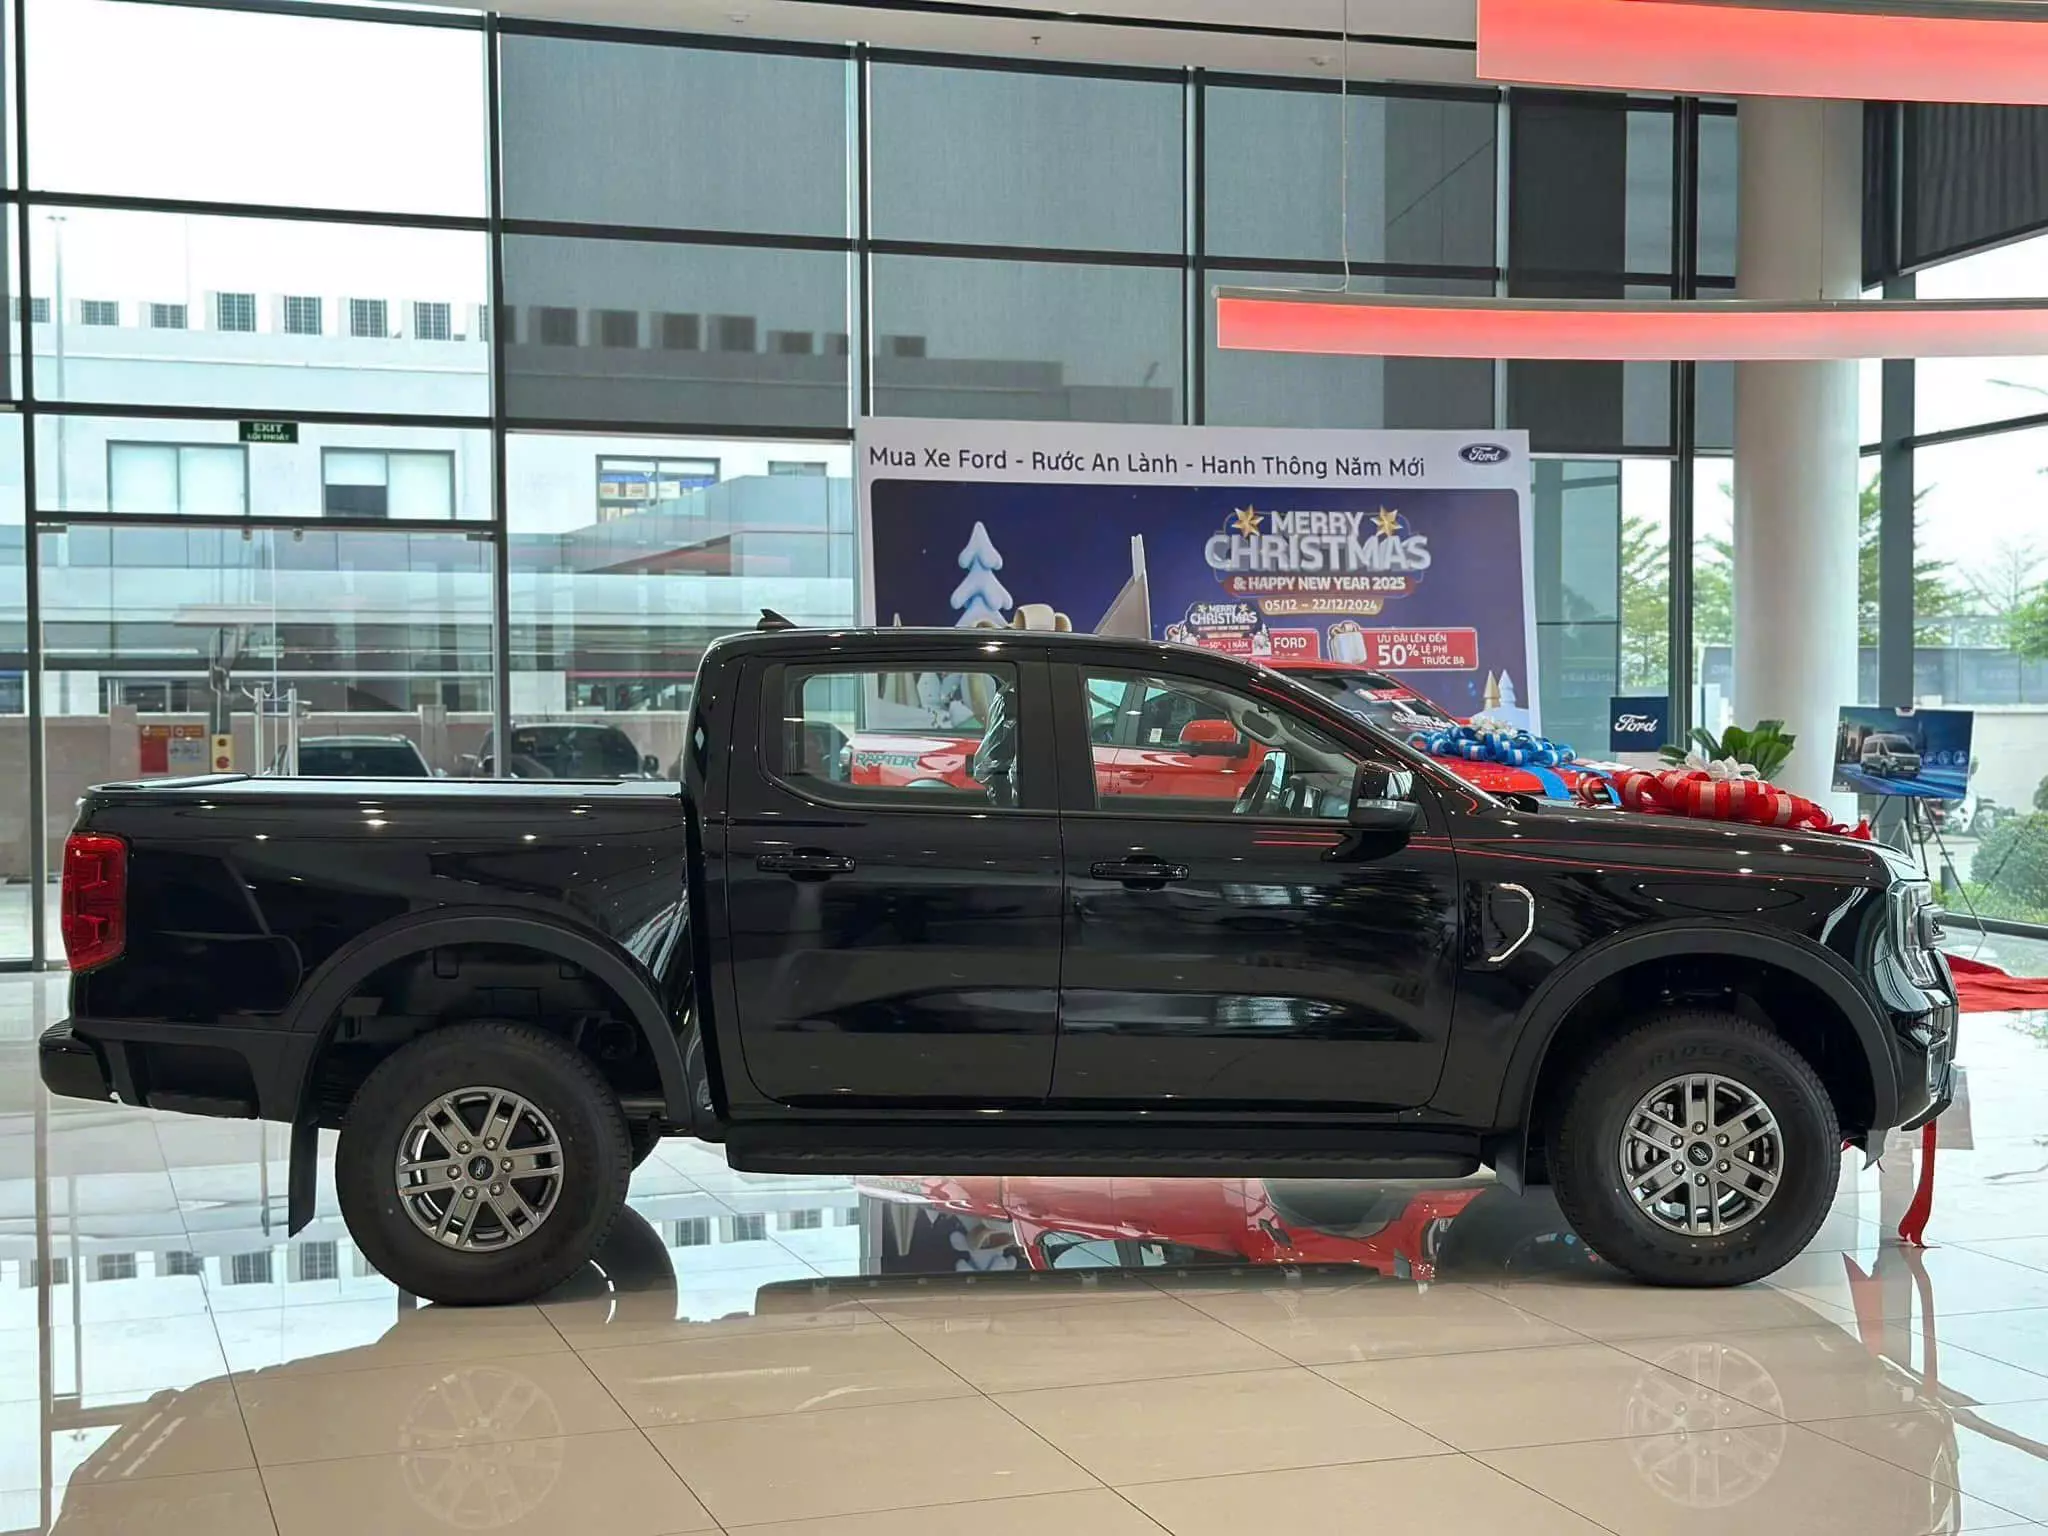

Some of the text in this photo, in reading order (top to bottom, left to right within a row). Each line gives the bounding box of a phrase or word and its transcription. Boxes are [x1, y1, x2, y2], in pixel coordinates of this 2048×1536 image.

[253, 423, 283, 432] EXIT
[870, 446, 916, 467] Mua
[924, 448, 950, 468] Xe
[959, 449, 1007, 469] Ford
[1032, 451, 1085, 471] Rước
[1092, 453, 1119, 472] An
[1127, 453, 1177, 473] Lành
[1202, 455, 1255, 475] Hanh
[1262, 457, 1328, 479] Thông
[1335, 457, 1381, 477] Năm
[1389, 457, 1425, 477] Mới
[1271, 511, 1364, 535] MERRY
[1204, 534, 1431, 572] CHRISTMAS
[1249, 576, 1296, 590] HAPPY
[1298, 576, 1335, 590] NEW
[1335, 577, 1370, 590] YEAR
[1373, 577, 1406, 590] 2025
[1265, 599, 1297, 610] 05/12
[1312, 599, 1377, 611] 22/12/2024
[1190, 611, 1257, 625] CHRISTMAS
[1273, 637, 1307, 649] FORD
[1378, 644, 1419, 666] 50%
[1614, 714, 1658, 732] Ford
[855, 753, 919, 770] RAPTOR
